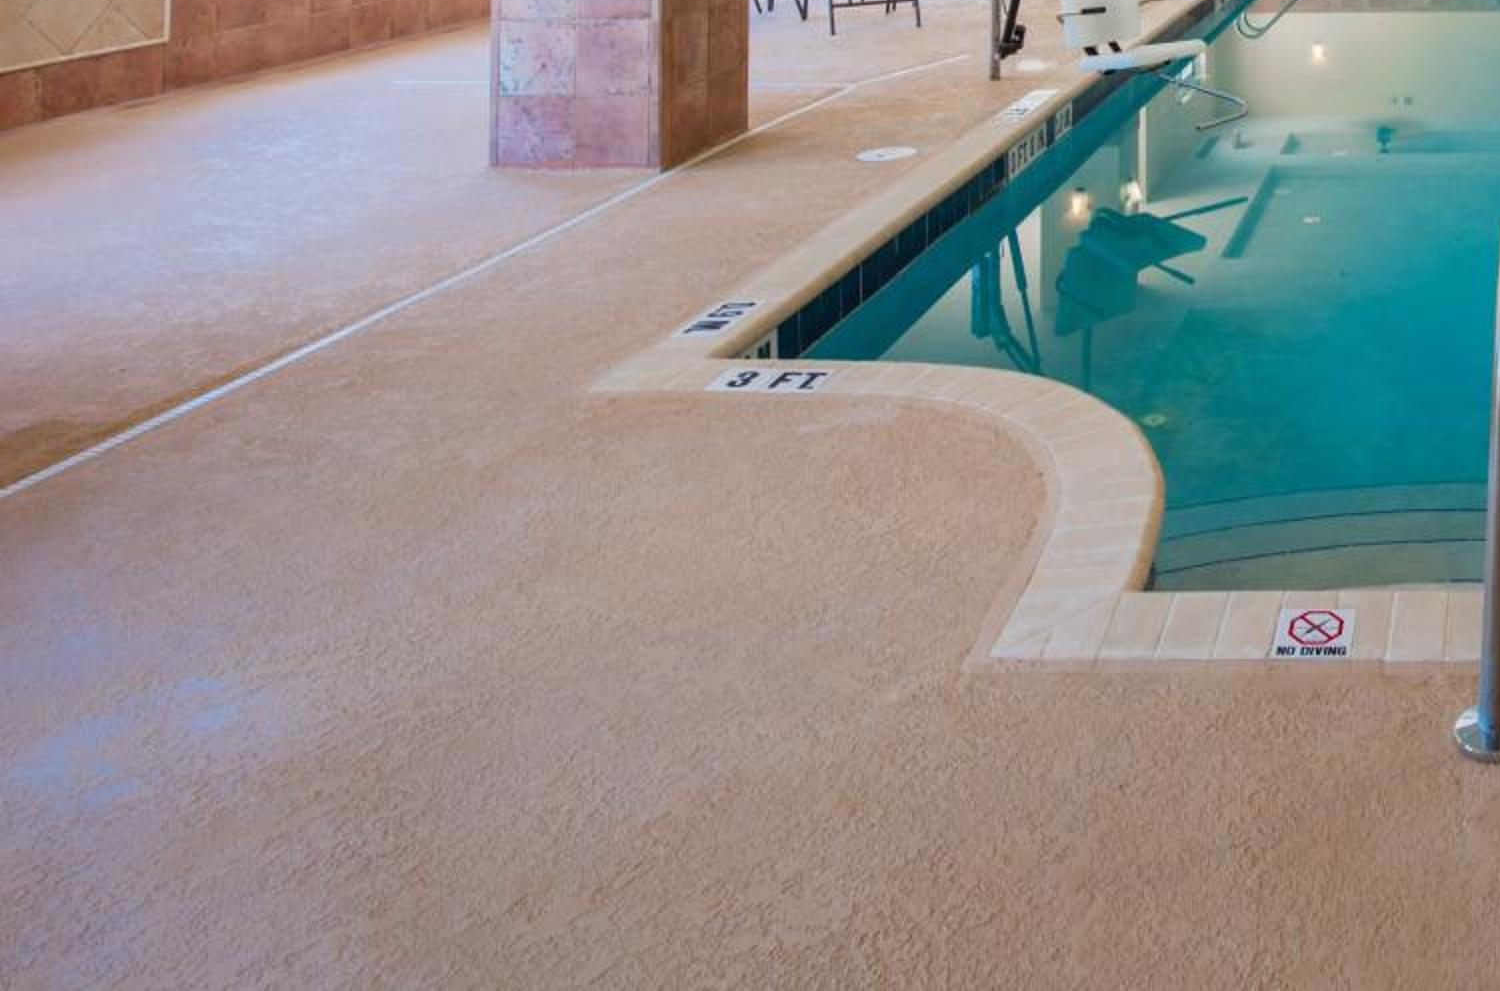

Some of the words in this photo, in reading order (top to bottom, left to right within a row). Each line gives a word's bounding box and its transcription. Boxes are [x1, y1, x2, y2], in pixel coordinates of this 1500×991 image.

[726, 370, 760, 388] 3
[1275, 645, 1296, 656] NO
[1299, 645, 1347, 657] DIVING
